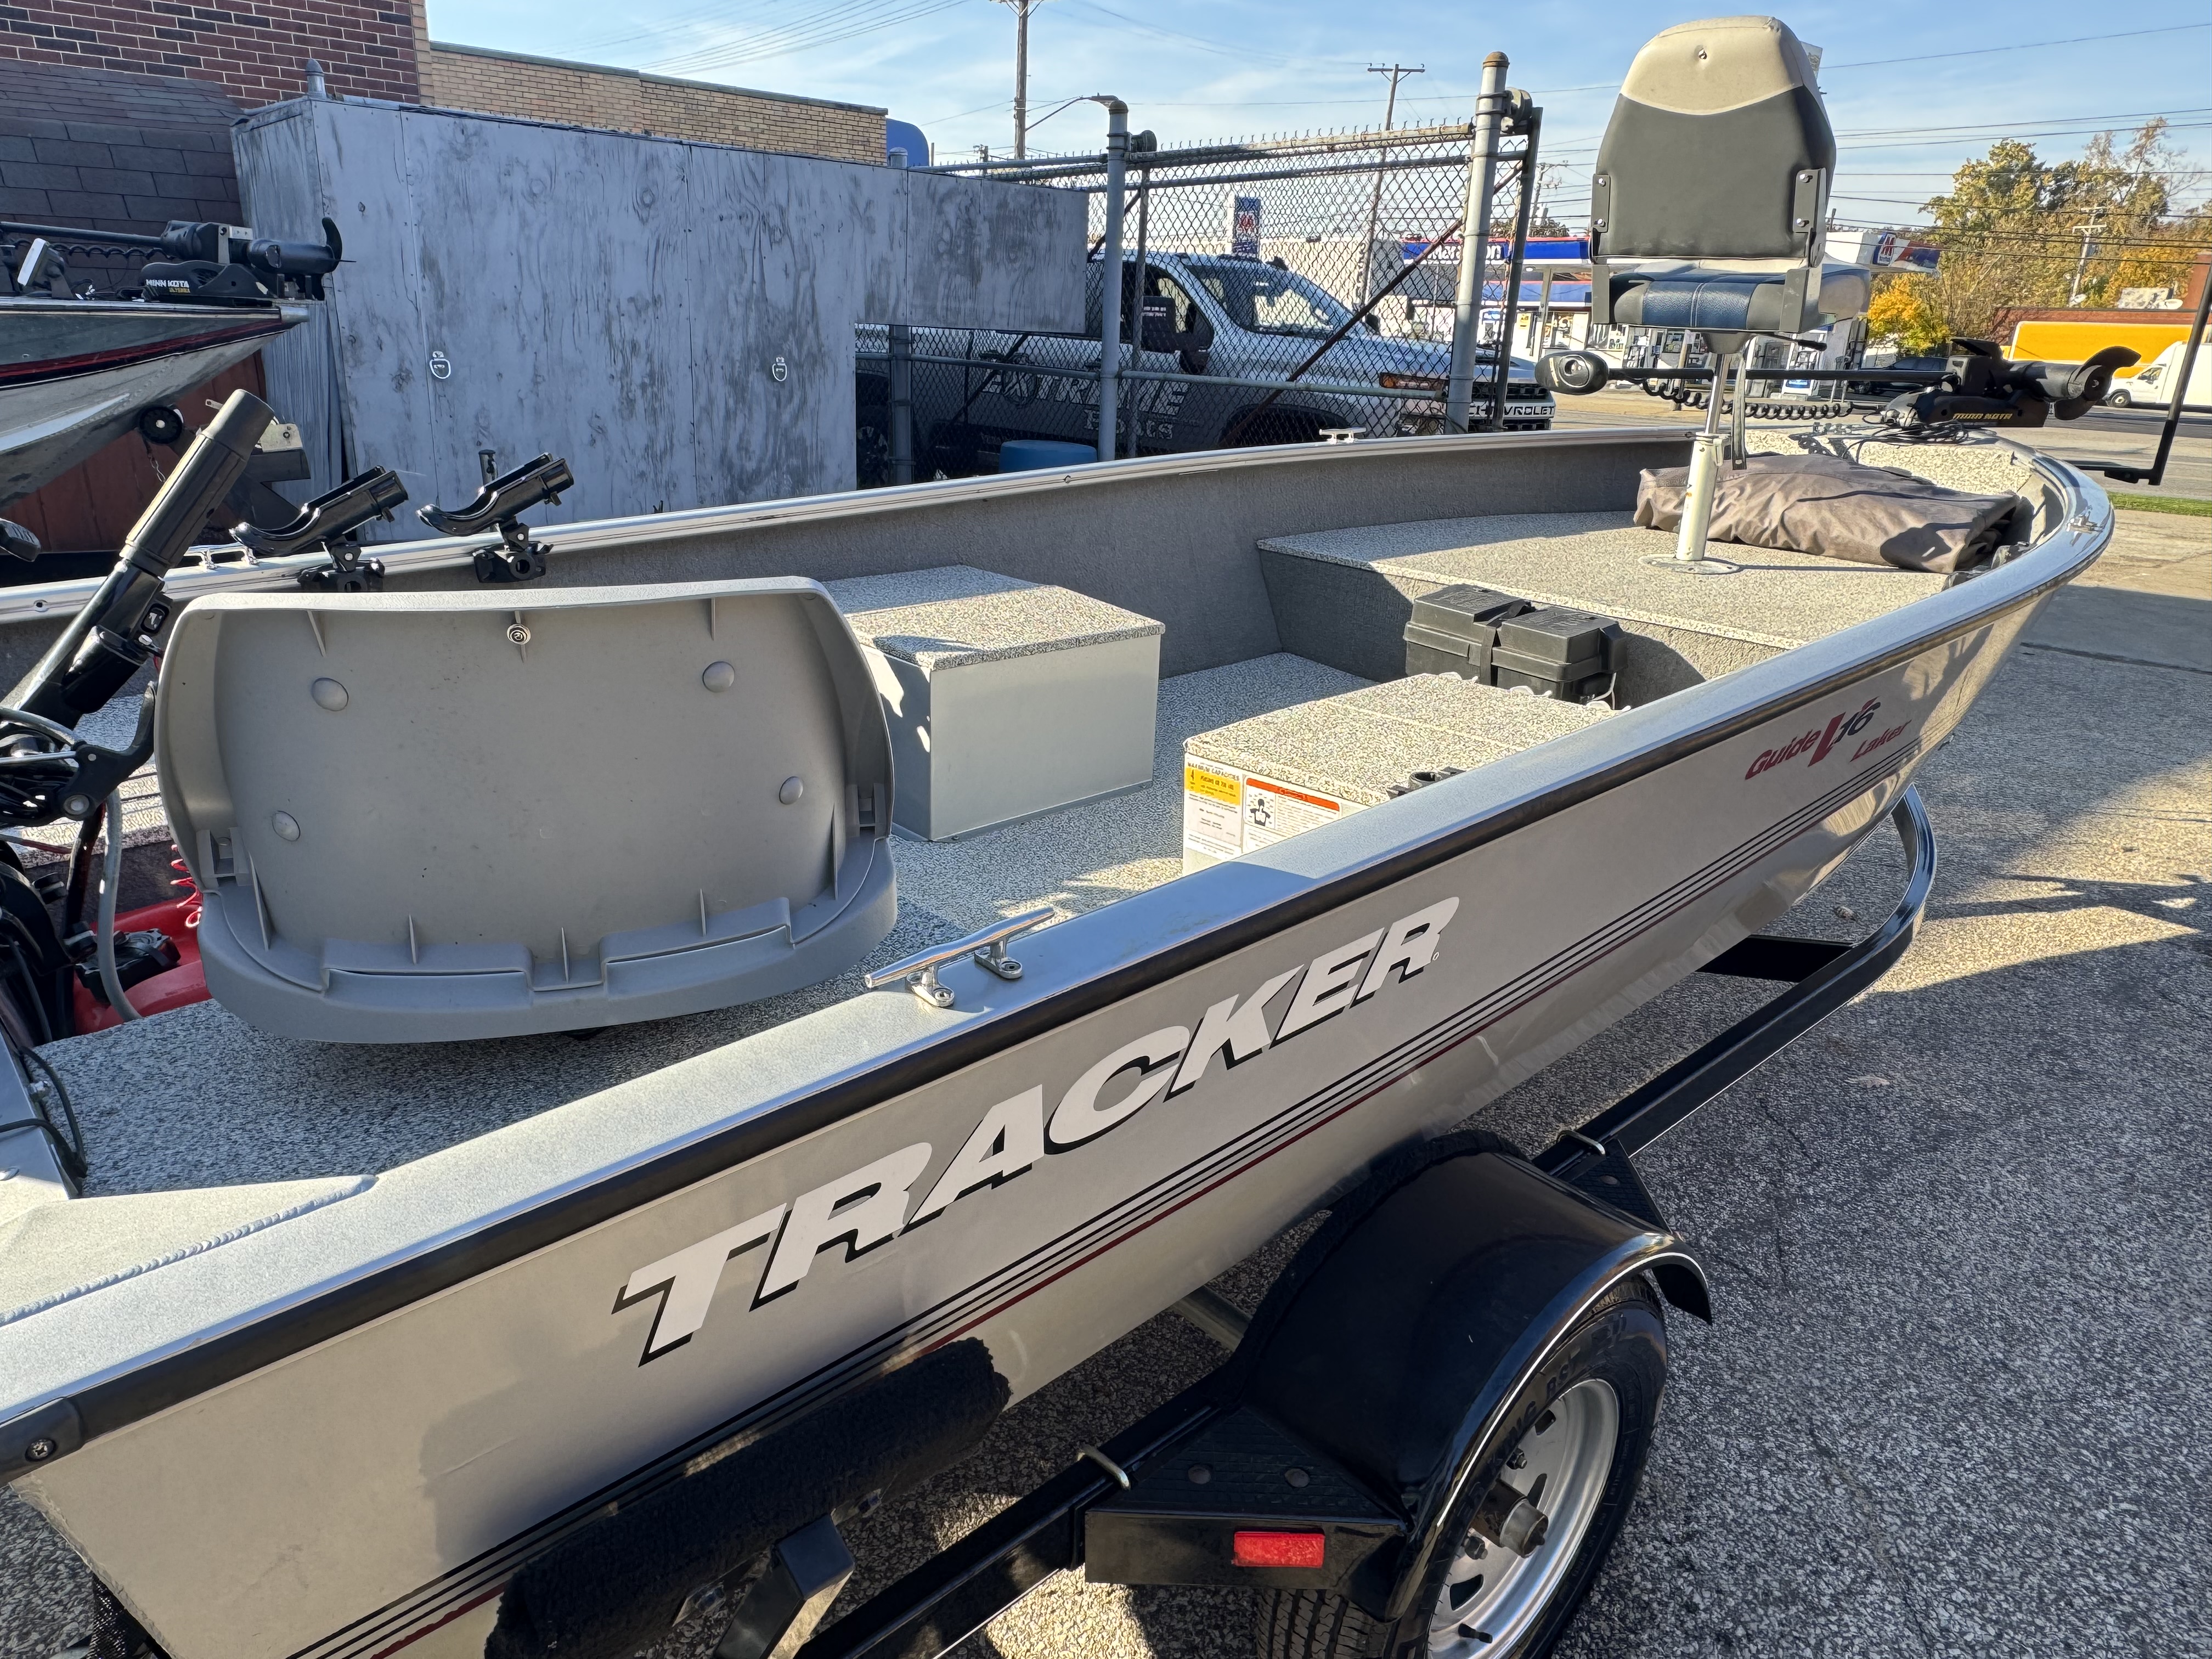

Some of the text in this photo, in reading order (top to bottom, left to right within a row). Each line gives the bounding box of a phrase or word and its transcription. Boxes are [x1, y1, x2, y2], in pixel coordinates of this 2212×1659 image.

[1427, 245, 1501, 259] Maraon
[1469, 404, 1555, 416] CHVROLET
[1745, 729, 1822, 780] Guide
[1849, 719, 1912, 763] Laker
[612, 896, 1460, 1368] TRACKER
